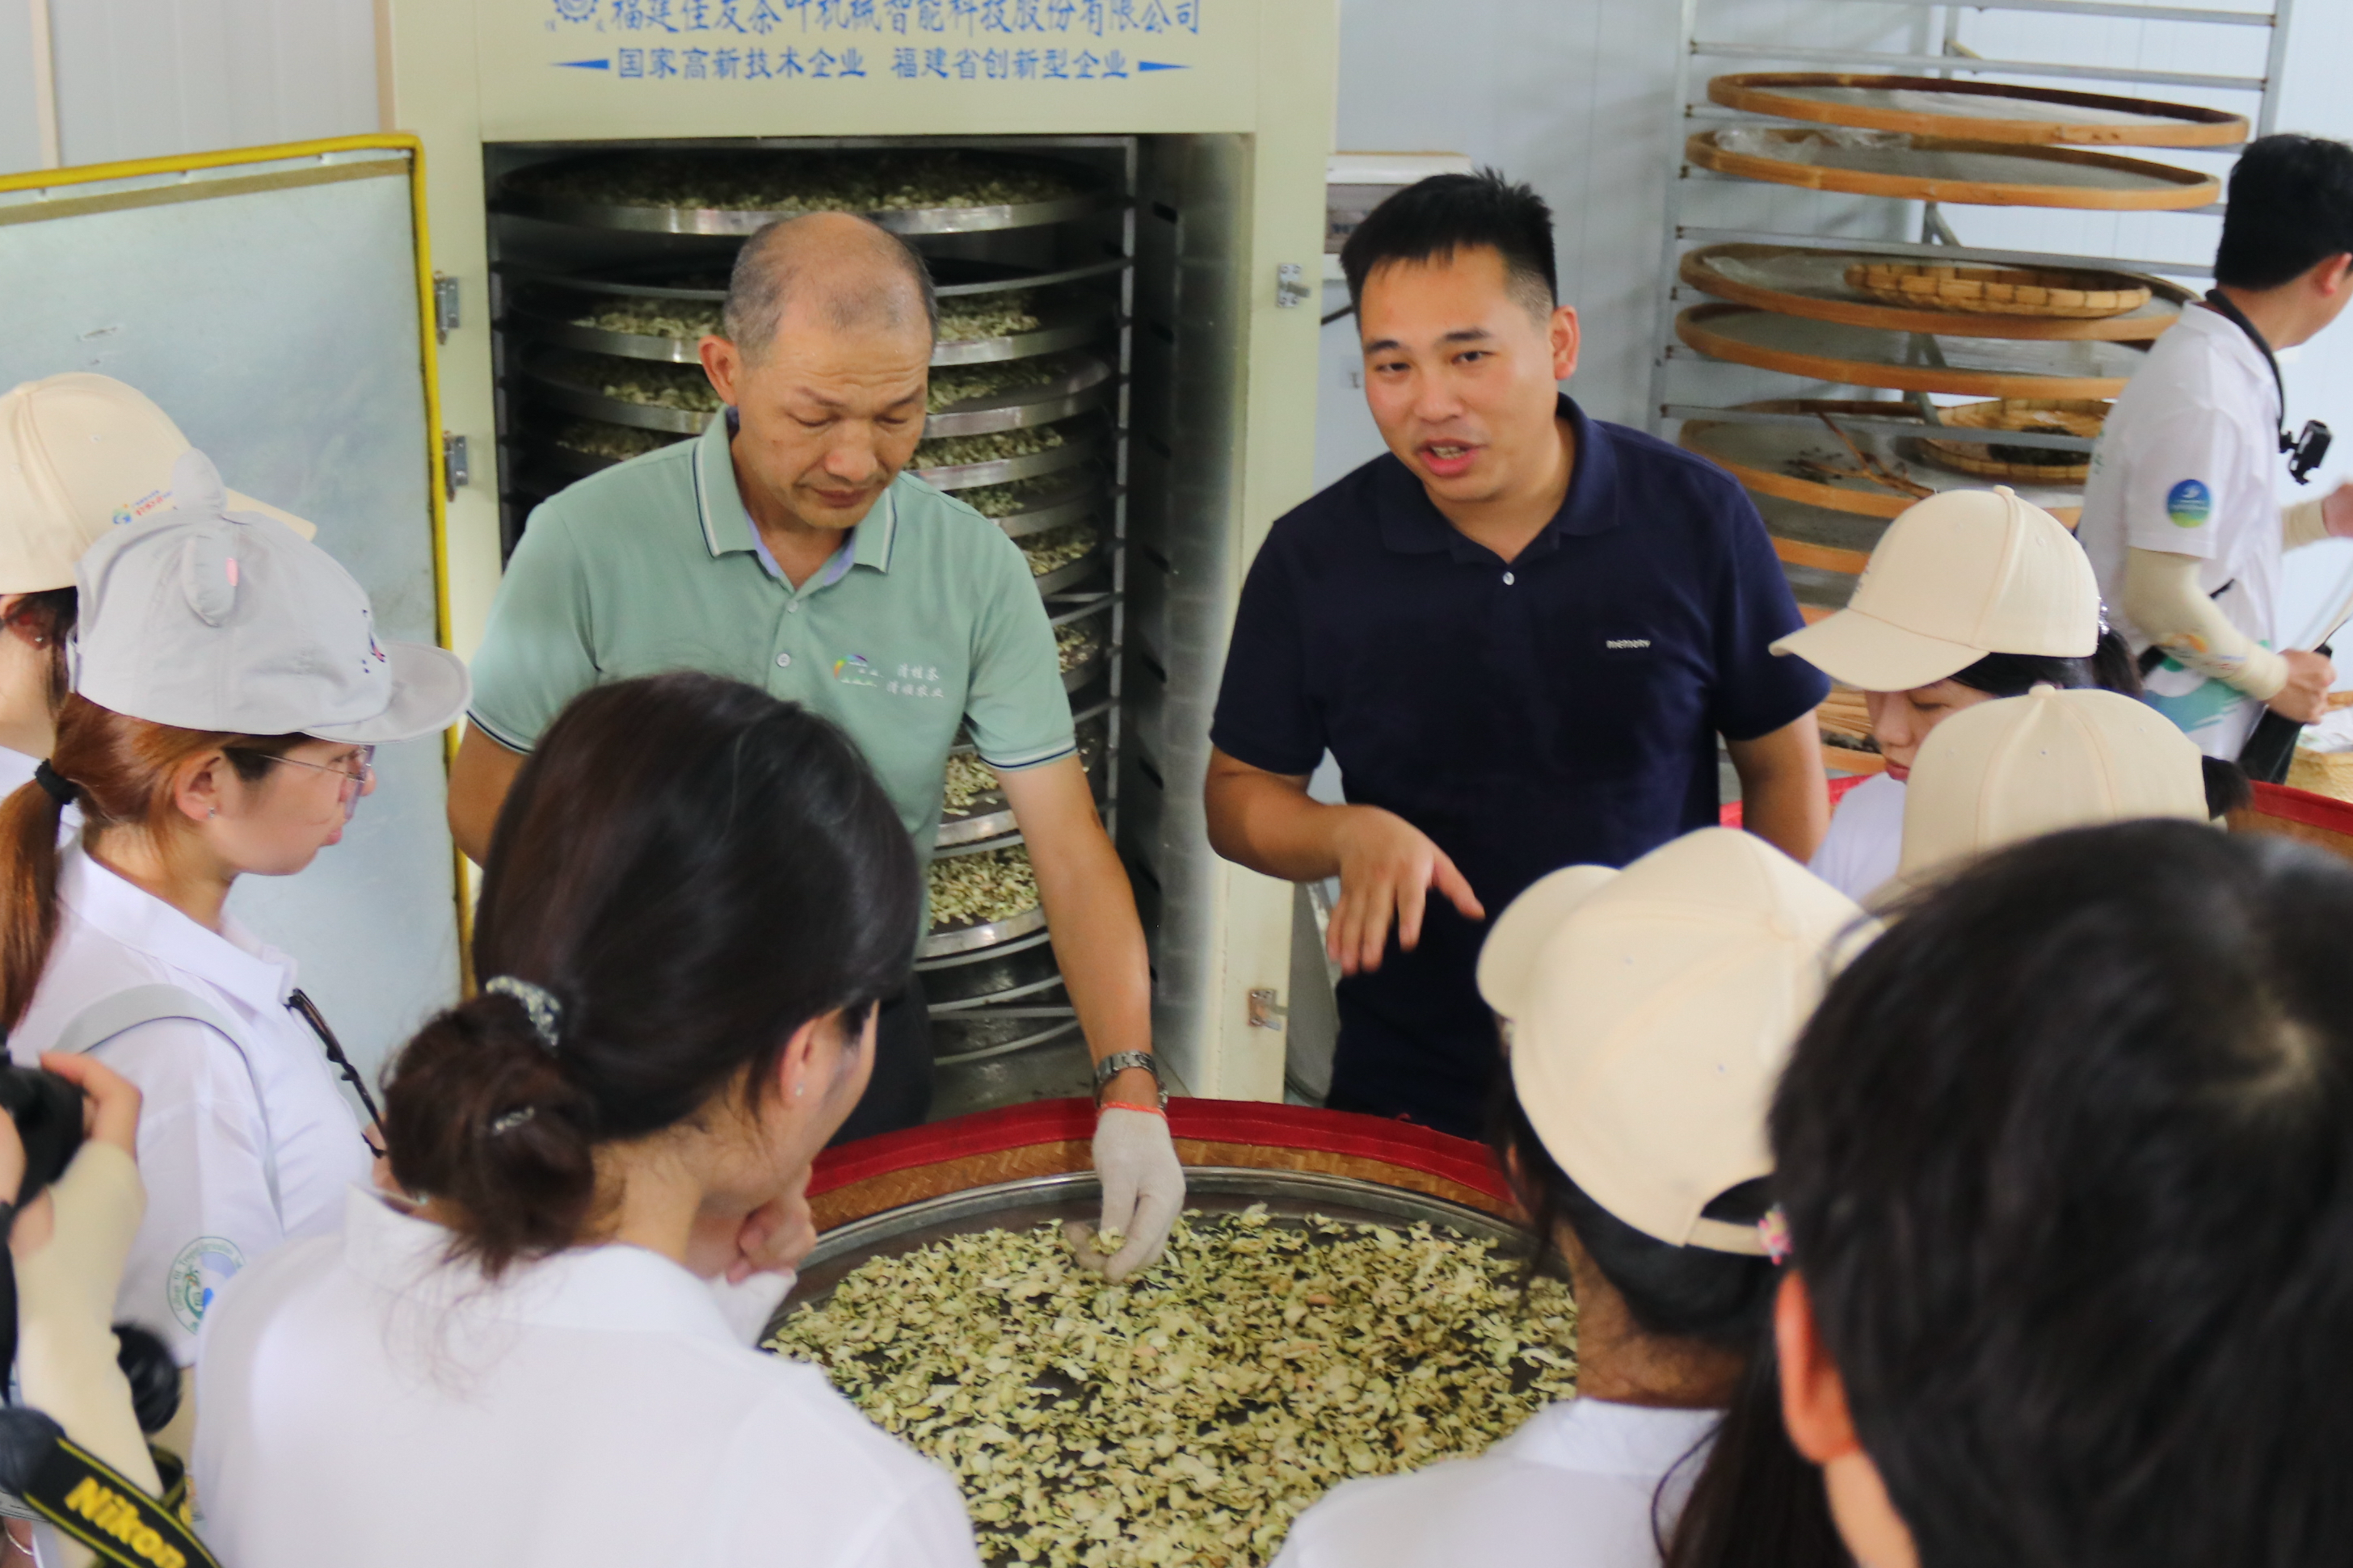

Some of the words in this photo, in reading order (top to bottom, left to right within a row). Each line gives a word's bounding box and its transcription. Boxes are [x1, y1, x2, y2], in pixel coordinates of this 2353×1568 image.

[619, 48, 866, 78] 国家高新技术企业
[890, 47, 1128, 78] 福建省创新型企业
[64, 1477, 187, 1568] Nikon
